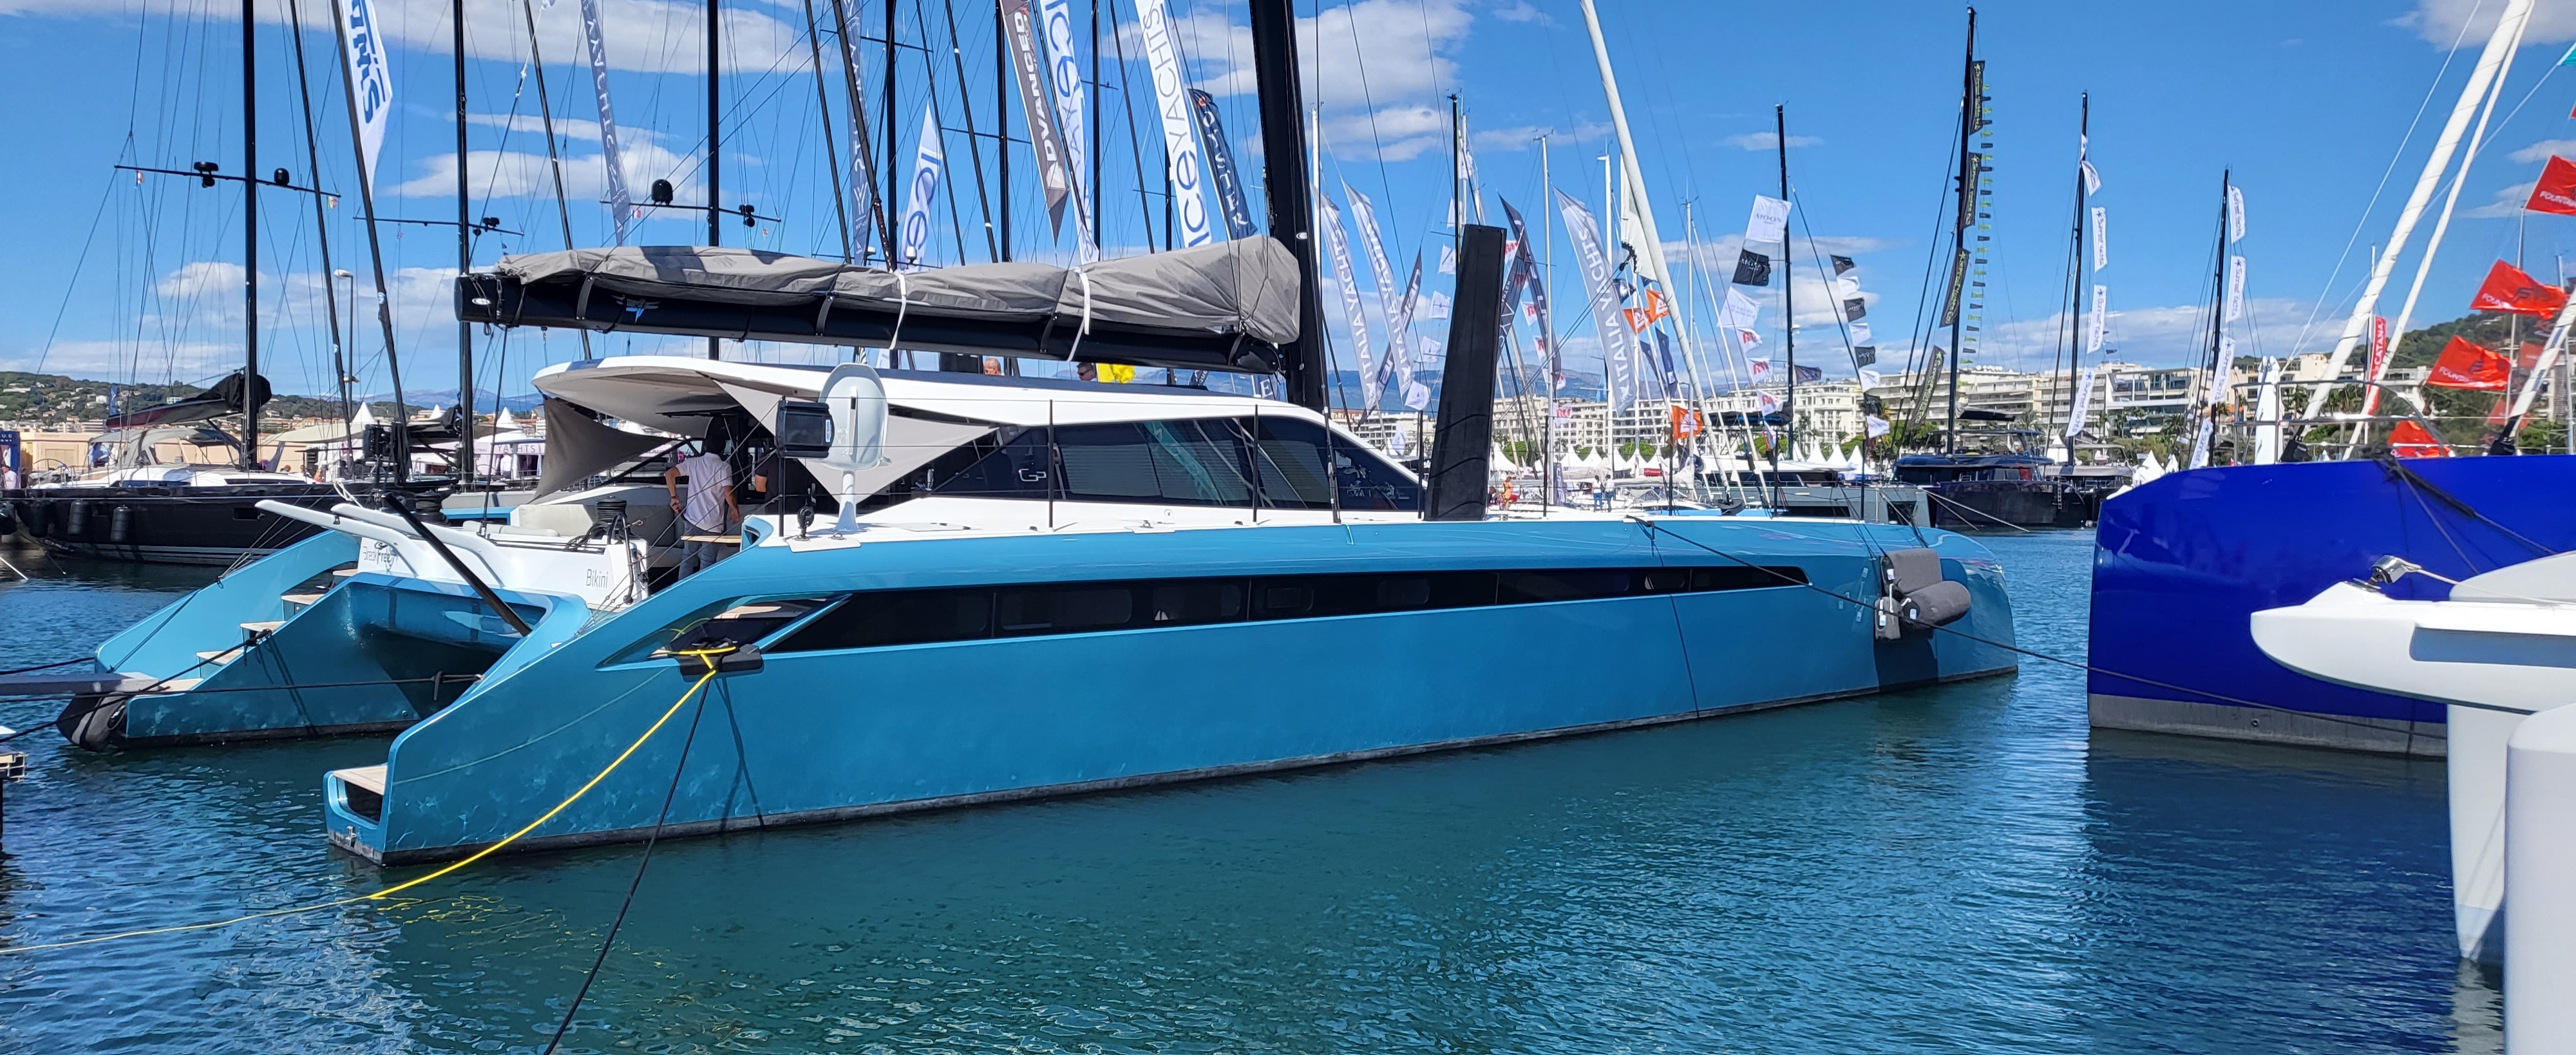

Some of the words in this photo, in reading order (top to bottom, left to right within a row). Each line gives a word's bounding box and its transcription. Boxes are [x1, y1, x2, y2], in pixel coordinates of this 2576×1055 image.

[1203, 111, 1248, 232] OYSTER
[1331, 229, 1359, 311] YACHTS
[1578, 229, 1613, 312] YACHTS
[1353, 312, 1372, 380] ITALIA
[1387, 299, 1408, 365] ITALIA
[1605, 314, 1631, 381] ITALIA
[2374, 318, 2385, 365] CATANA
[2071, 410, 2086, 433] Yachts
[2079, 382, 2092, 409] Sunreef
[498, 444, 536, 453] YAHTS
[586, 569, 609, 588] Bikini
